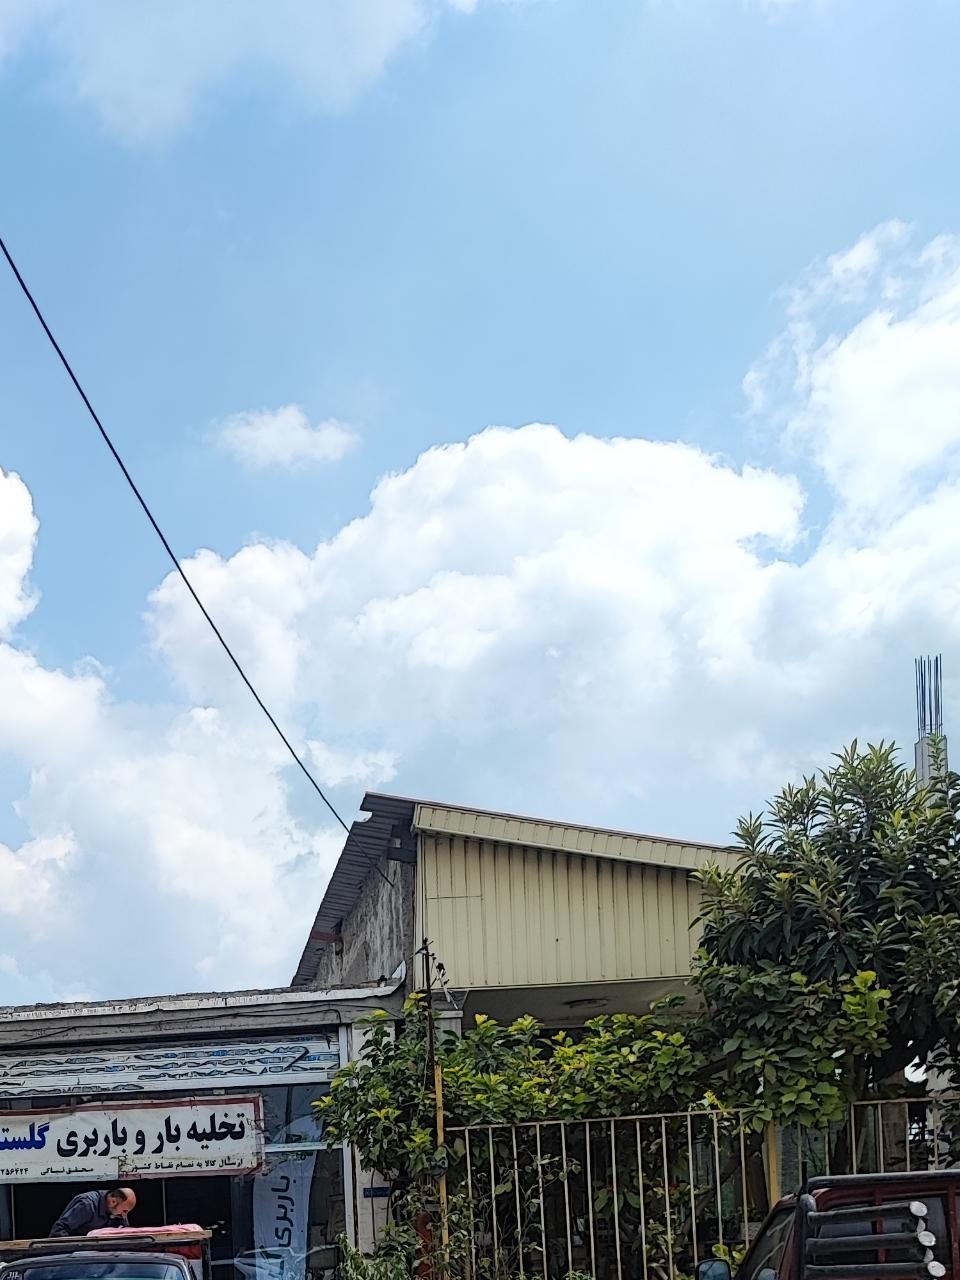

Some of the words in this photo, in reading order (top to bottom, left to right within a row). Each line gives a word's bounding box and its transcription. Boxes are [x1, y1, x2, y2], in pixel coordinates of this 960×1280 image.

[56, 1117, 128, 1157] باربری
[132, 1129, 146, 1155] و
[152, 1115, 181, 1154] بار
[187, 1112, 246, 1150] تخلیه
[271, 1175, 297, 1248] باربری
